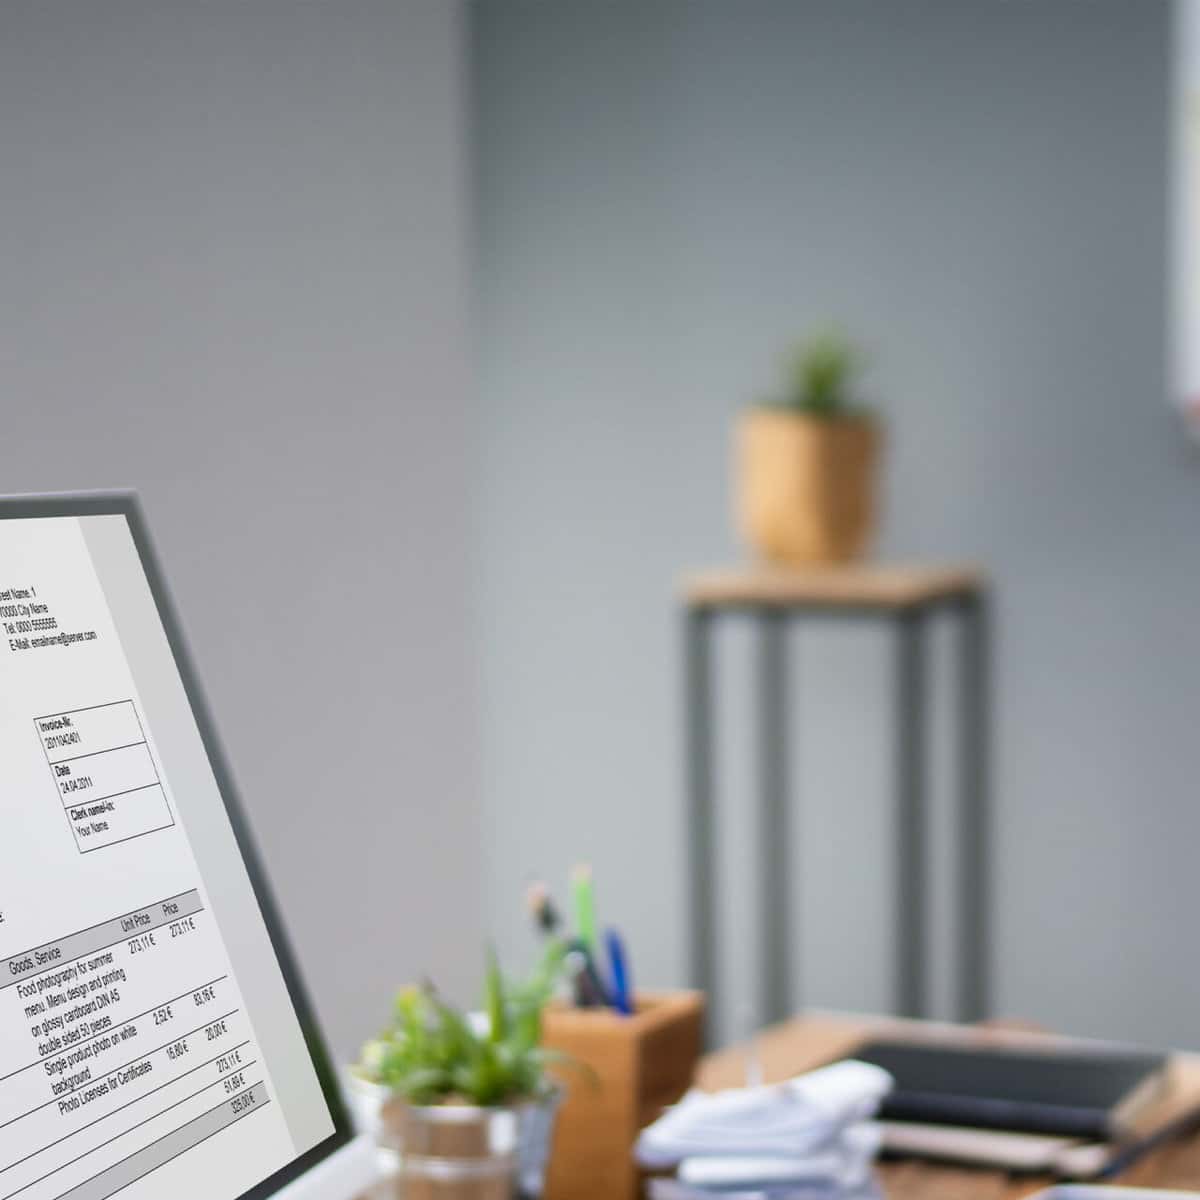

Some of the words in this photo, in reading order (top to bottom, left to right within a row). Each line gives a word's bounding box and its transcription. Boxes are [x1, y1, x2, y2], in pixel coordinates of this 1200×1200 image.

[17, 604, 31, 618] City
[29, 602, 49, 614] Name
[55, 765, 71, 777] Date
[60, 776, 93, 794] 24.04.2011
[70, 808, 88, 821] Clerk
[75, 825, 91, 838] Your
[90, 821, 109, 833] Name
[162, 903, 179, 917] Price
[120, 917, 136, 932] Unit
[134, 913, 151, 928] Price
[35, 947, 61, 966] Service
[16, 980, 37, 999] Food
[36, 966, 79, 995] photography
[77, 961, 88, 975] for
[87, 952, 114, 971] summer
[46, 993, 67, 1009] Menu
[66, 982, 89, 999] design
[88, 976, 102, 992] and
[101, 968, 127, 986] printing
[31, 1025, 42, 1038] on
[41, 1015, 65, 1036] glossy
[64, 999, 98, 1023] cardboard
[96, 992, 111, 1010] DIN
[110, 988, 120, 1004] A5
[38, 1036, 62, 1056] double
[61, 1027, 81, 1046] sided
[80, 1022, 91, 1037] 50
[90, 1015, 112, 1036] pieces
[44, 1057, 68, 1076] Single
[67, 1043, 93, 1069] product
[92, 1037, 112, 1057] photo
[111, 1033, 121, 1046] on
[120, 1025, 138, 1040] white
[51, 1066, 91, 1095] background
[58, 1098, 81, 1116] Photo
[79, 1083, 110, 1105] Licenses
[108, 1076, 118, 1090] for
[117, 1060, 153, 1085] Certificates
